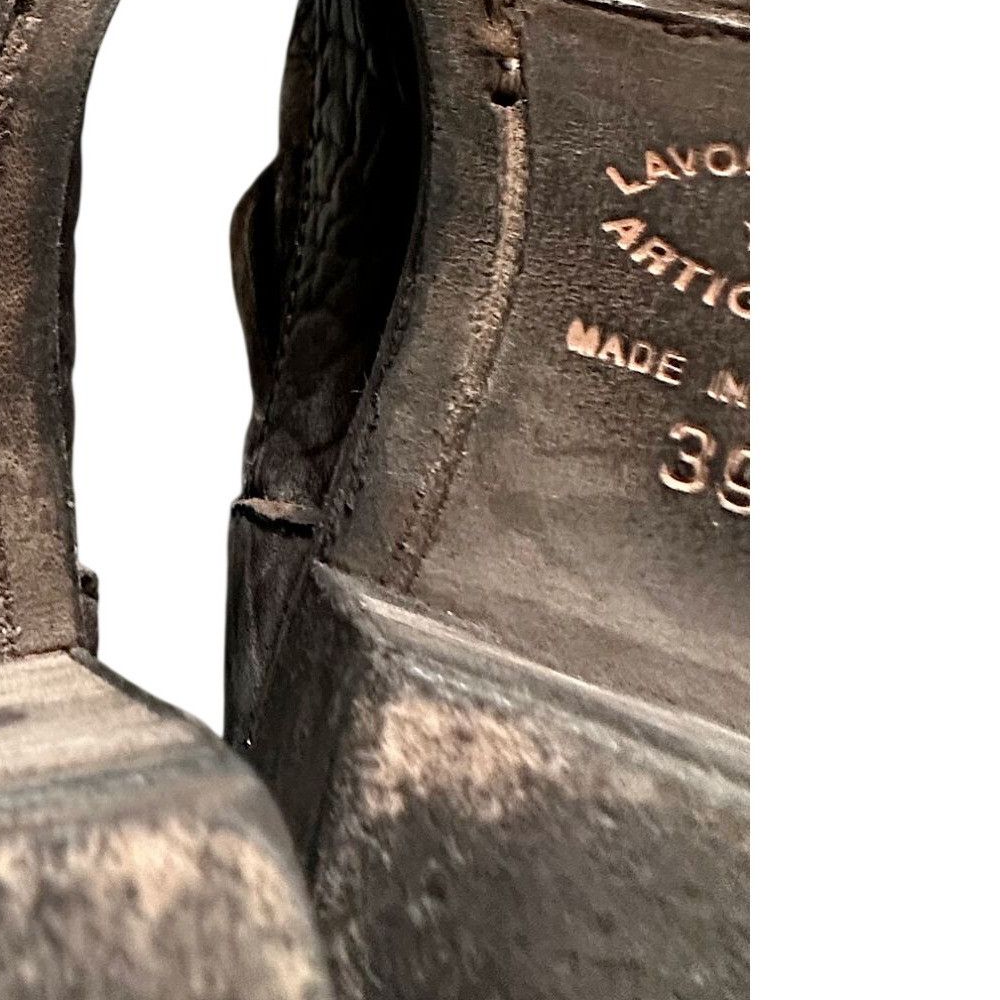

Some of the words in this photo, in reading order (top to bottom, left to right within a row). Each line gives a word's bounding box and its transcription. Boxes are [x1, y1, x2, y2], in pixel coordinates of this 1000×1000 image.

[605, 141, 750, 196] LAVO
[566, 315, 688, 386] MADE
[706, 367, 750, 410] IN
